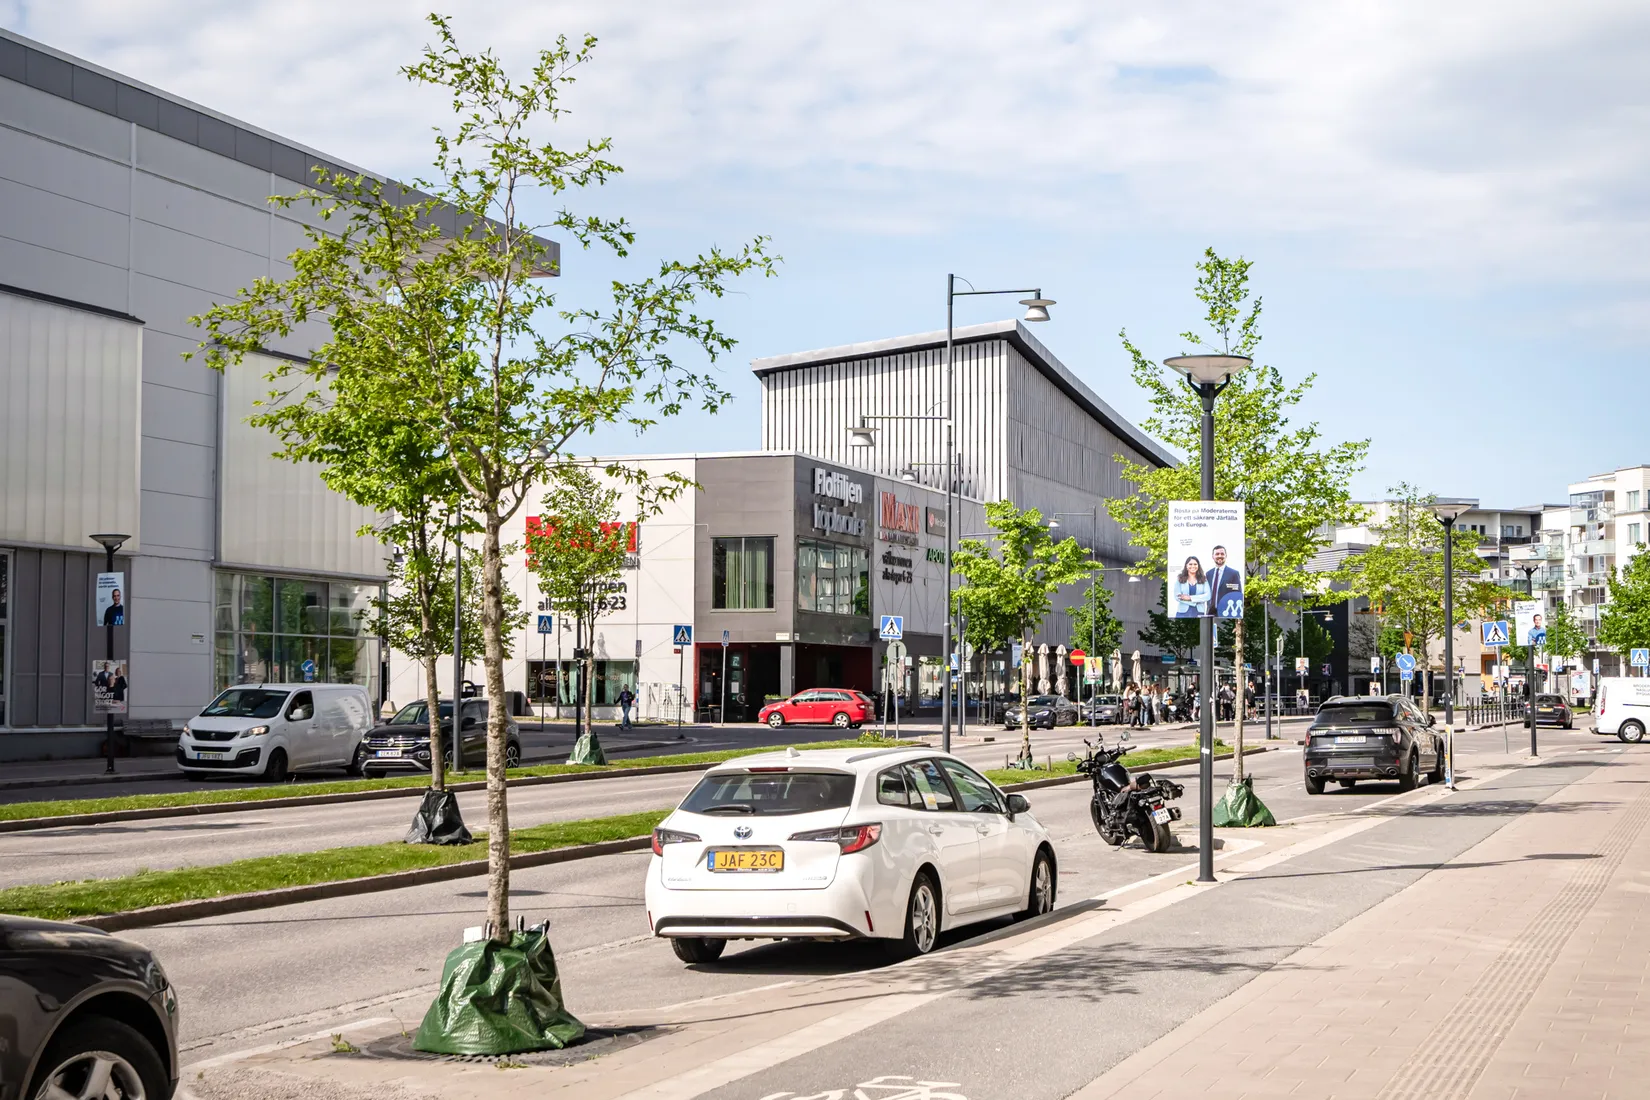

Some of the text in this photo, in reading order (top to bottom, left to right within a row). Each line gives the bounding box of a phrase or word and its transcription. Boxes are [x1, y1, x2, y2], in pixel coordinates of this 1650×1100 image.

[813, 467, 863, 507] Flottiljen
[720, 853, 776, 867] JAF 23C
